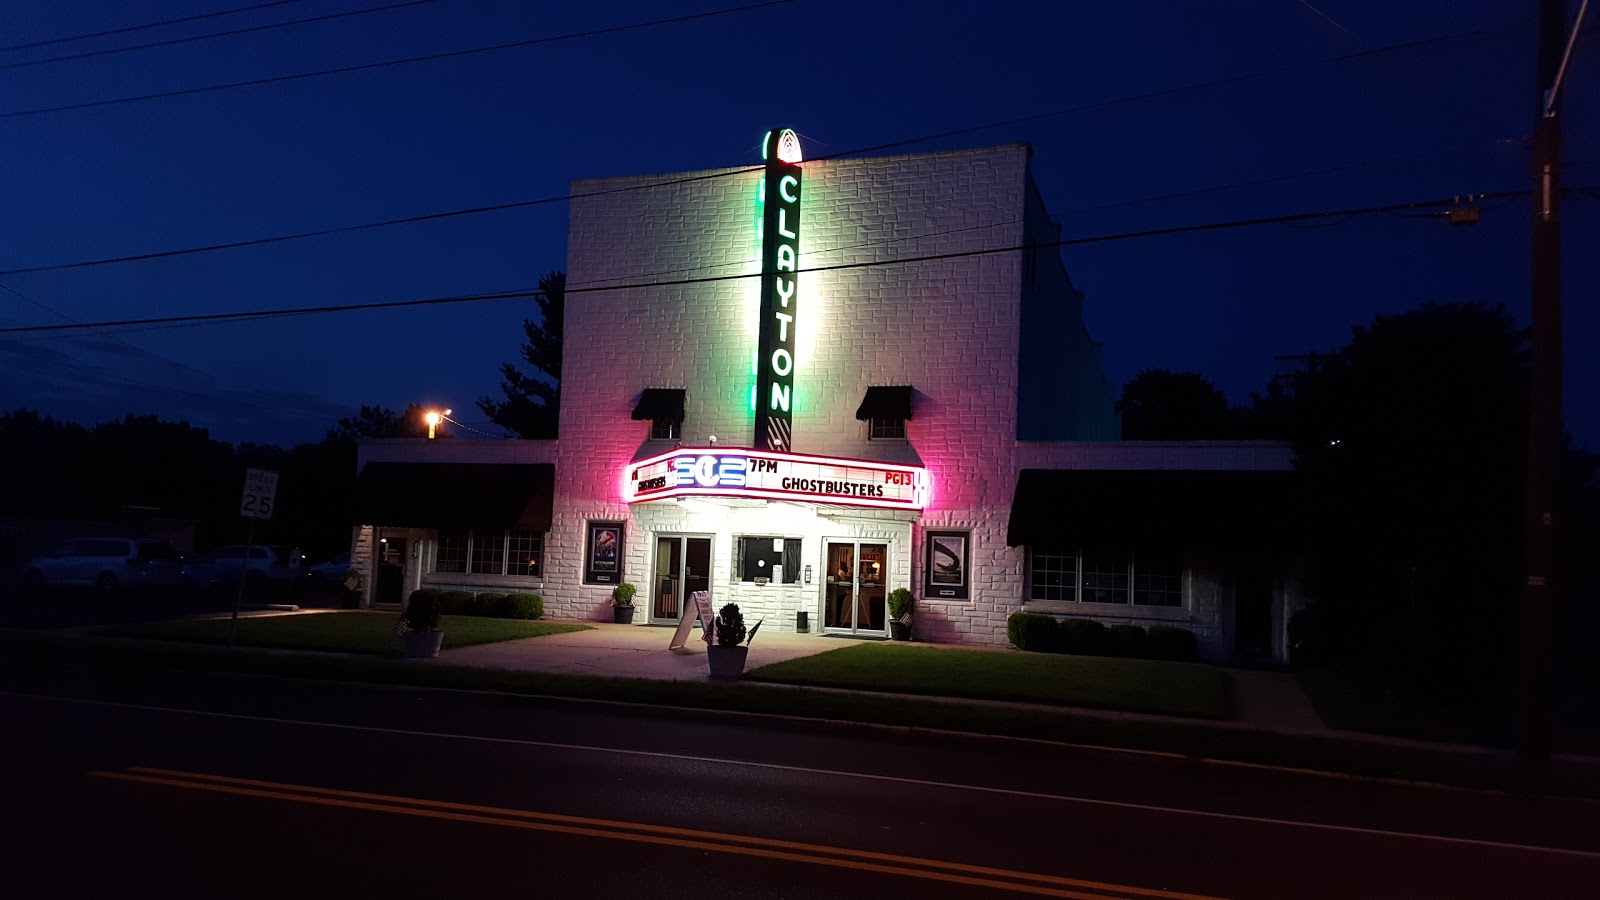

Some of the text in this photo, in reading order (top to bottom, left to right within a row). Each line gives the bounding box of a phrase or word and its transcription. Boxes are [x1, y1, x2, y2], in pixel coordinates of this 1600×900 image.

[770, 175, 798, 413] CLAYTON
[749, 458, 778, 474] 7PM
[781, 477, 884, 498] GHOSTBUSTERS
[884, 471, 912, 486] PG13
[243, 494, 271, 514] 25
